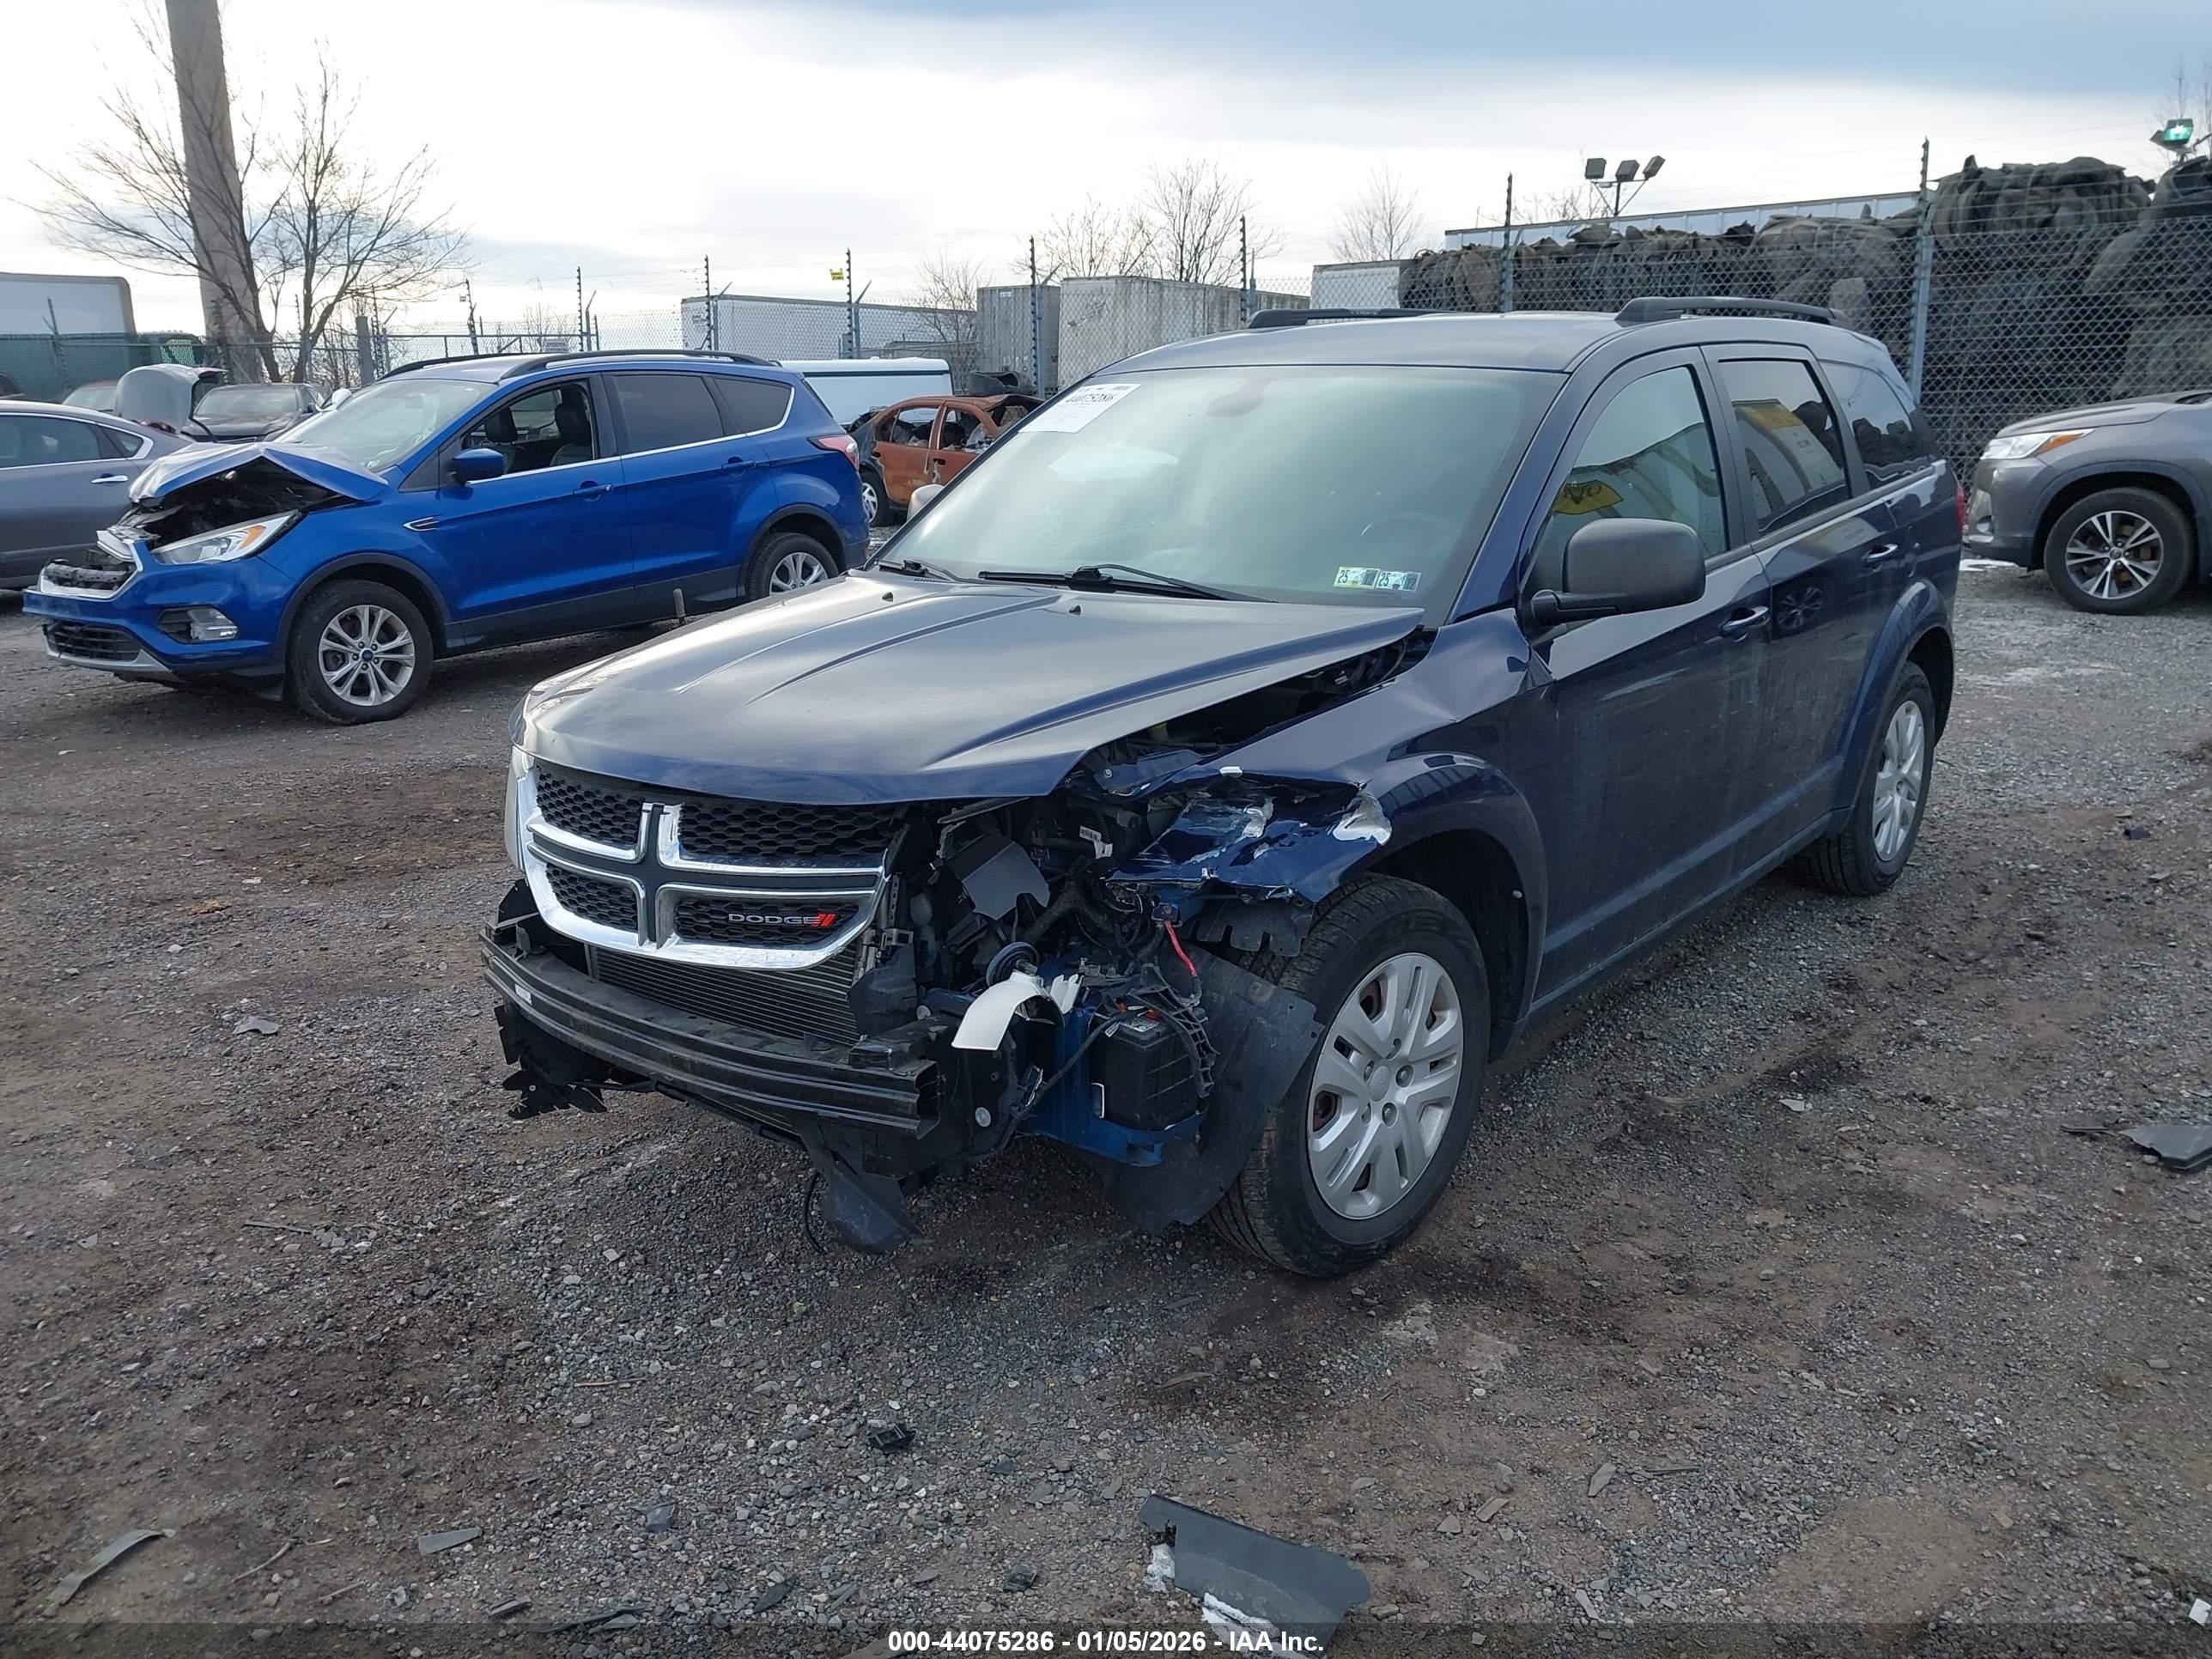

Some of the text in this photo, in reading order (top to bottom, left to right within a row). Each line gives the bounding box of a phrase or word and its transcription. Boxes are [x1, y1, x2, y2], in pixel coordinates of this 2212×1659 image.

[1337, 569, 1350, 584] 25
[1378, 572, 1391, 586] 25
[728, 913, 821, 925] DODGE
